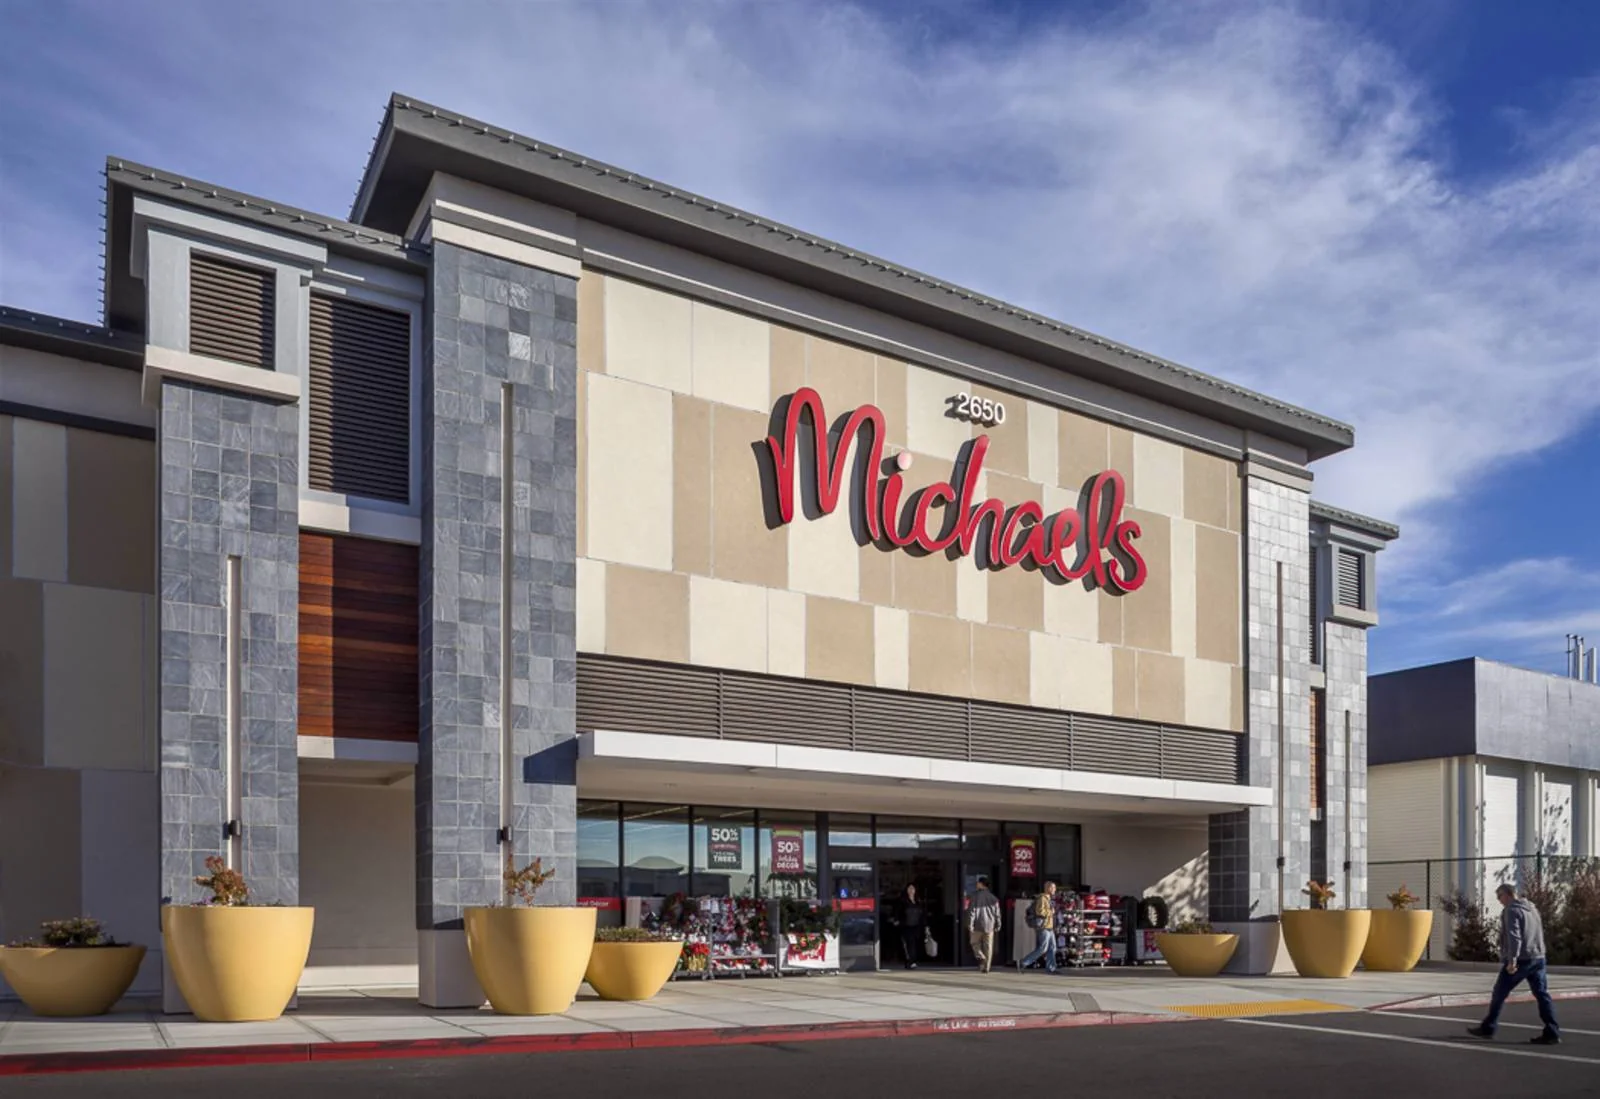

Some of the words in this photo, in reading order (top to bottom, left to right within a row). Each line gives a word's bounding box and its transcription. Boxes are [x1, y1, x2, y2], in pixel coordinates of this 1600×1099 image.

[957, 391, 1007, 425] 2650
[767, 386, 1148, 592] Michaels
[713, 855, 737, 863] TREES
